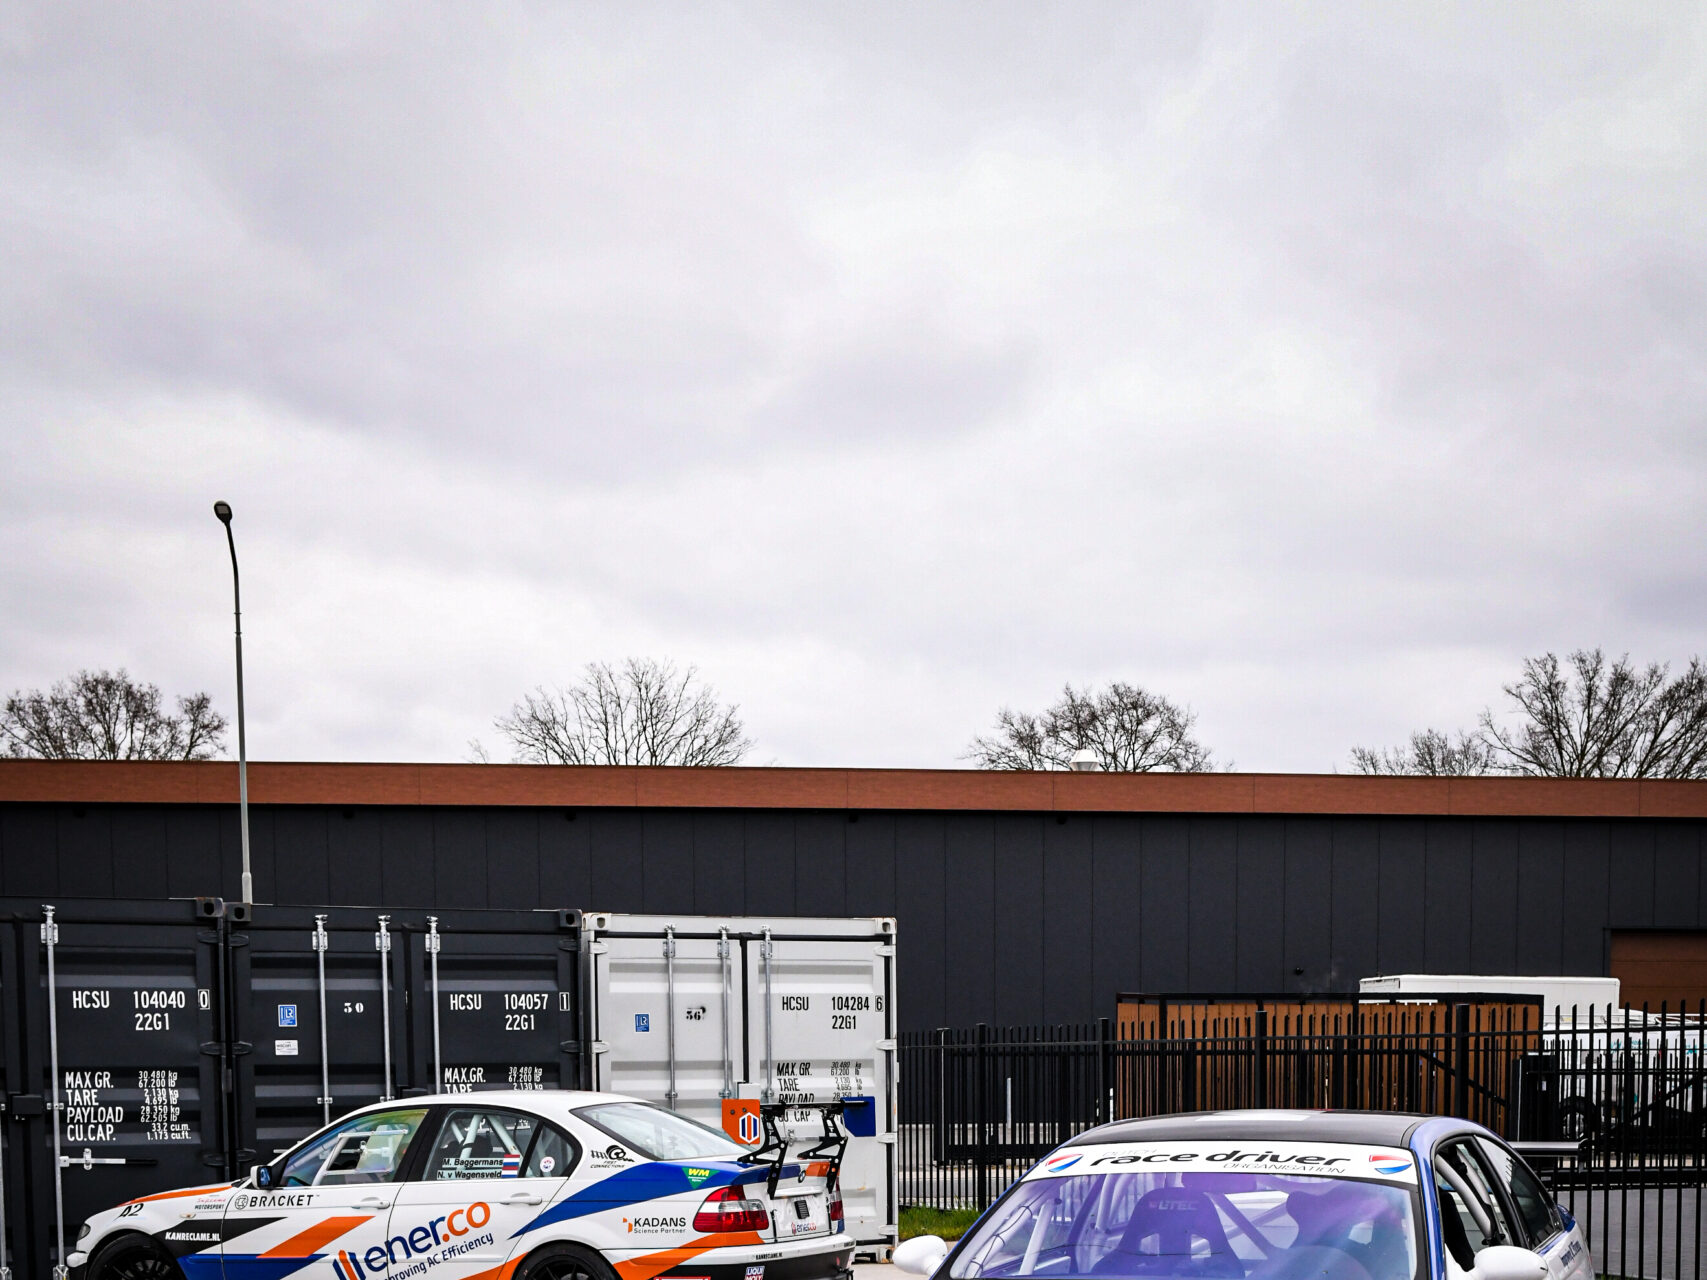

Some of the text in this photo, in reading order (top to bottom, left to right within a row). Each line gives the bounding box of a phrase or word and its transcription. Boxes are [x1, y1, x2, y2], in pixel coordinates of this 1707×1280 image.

[72, 990, 110, 1008] HCSU
[133, 990, 186, 1008] 104040
[450, 994, 482, 1010] HCSU
[504, 994, 548, 1010] 104057
[782, 996, 809, 1010] HCSU
[832, 996, 869, 1010] 104284
[134, 1013, 170, 1030] 22G1
[505, 1014, 534, 1030] 22G1
[832, 1015, 856, 1029] 22G1
[138, 1071, 177, 1080] 30.480 kg
[534, 1067, 542, 1075] kg
[65, 1072, 114, 1088] MAX GR.
[138, 1079, 176, 1088] 67.200 lb
[777, 1078, 800, 1091] TARE
[66, 1089, 99, 1106] TARE
[144, 1089, 179, 1098] 2.130 kg
[169, 1097, 177, 1105] lb
[67, 1107, 124, 1123] PAYLOAD
[170, 1106, 180, 1115] kg
[67, 1124, 116, 1141] CU.CAP.
[454, 1158, 503, 1167] Baggermans
[1090, 1150, 1351, 1166] race driver
[454, 1170, 502, 1179] Wagensveld
[250, 1194, 314, 1207] BRACKET
[634, 1218, 686, 1228] KADANS
[165, 1232, 221, 1241] KANRECLAME.NL
[364, 1202, 490, 1272] ener.co
[428, 1253, 440, 1268] AC
[442, 1232, 494, 1260] Efficiency
